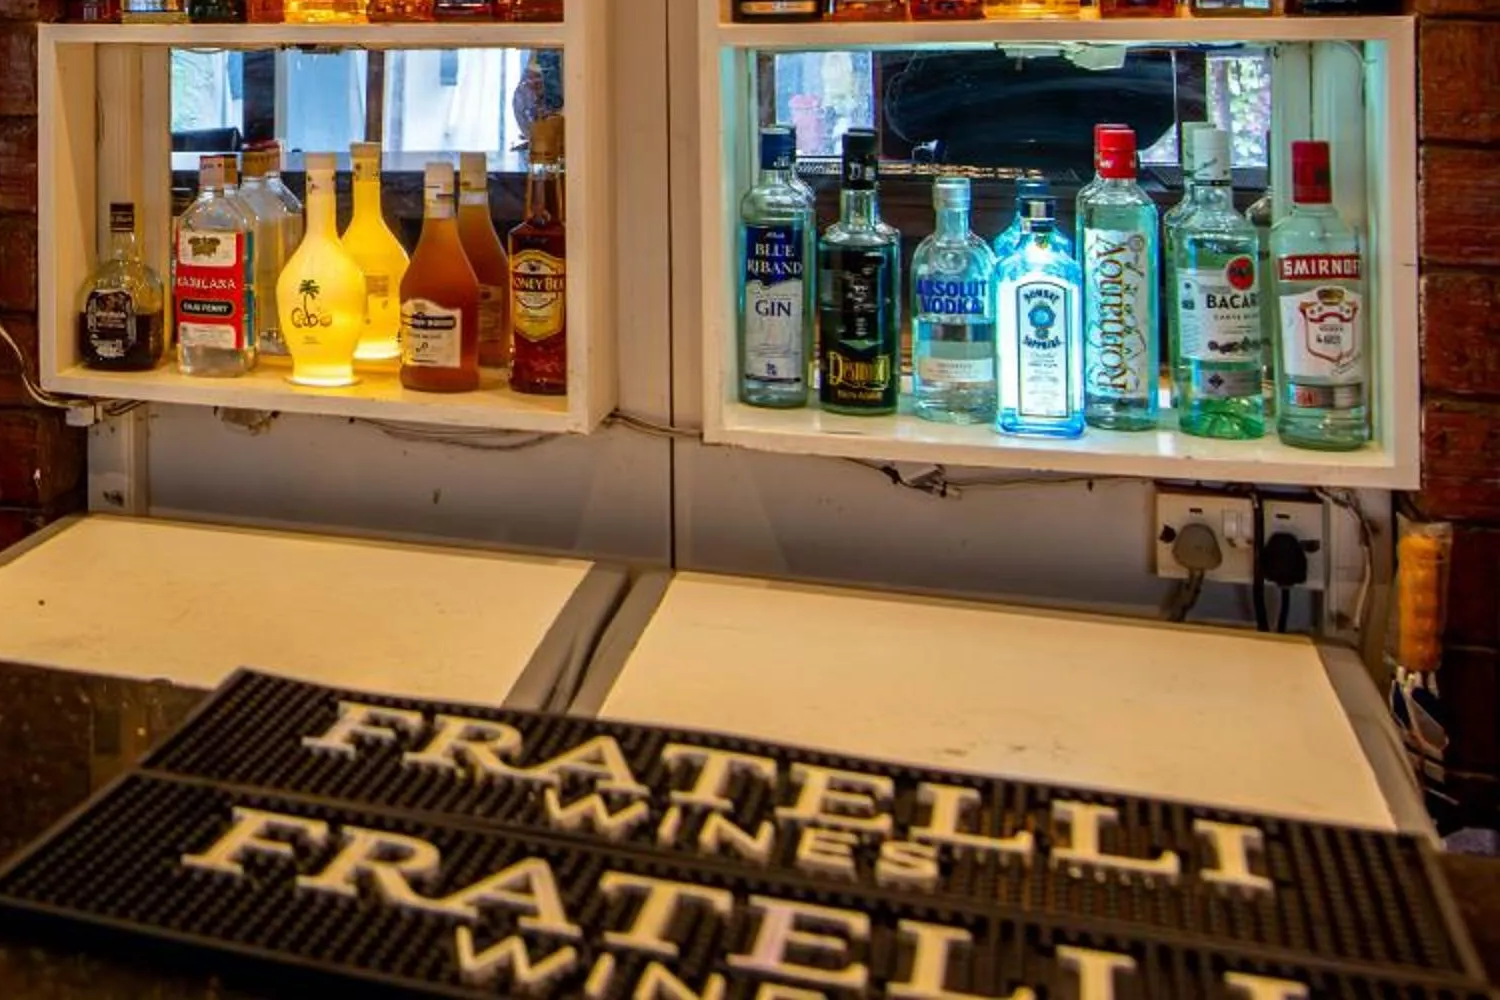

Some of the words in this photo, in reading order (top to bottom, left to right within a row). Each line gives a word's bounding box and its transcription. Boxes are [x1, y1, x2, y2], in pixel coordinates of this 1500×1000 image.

[755, 242, 795, 258] BLUE
[747, 259, 803, 276] RIBAND
[755, 301, 792, 317] GIN
[301, 699, 1273, 892] FRATELLI
[545, 787, 941, 890] WINES
